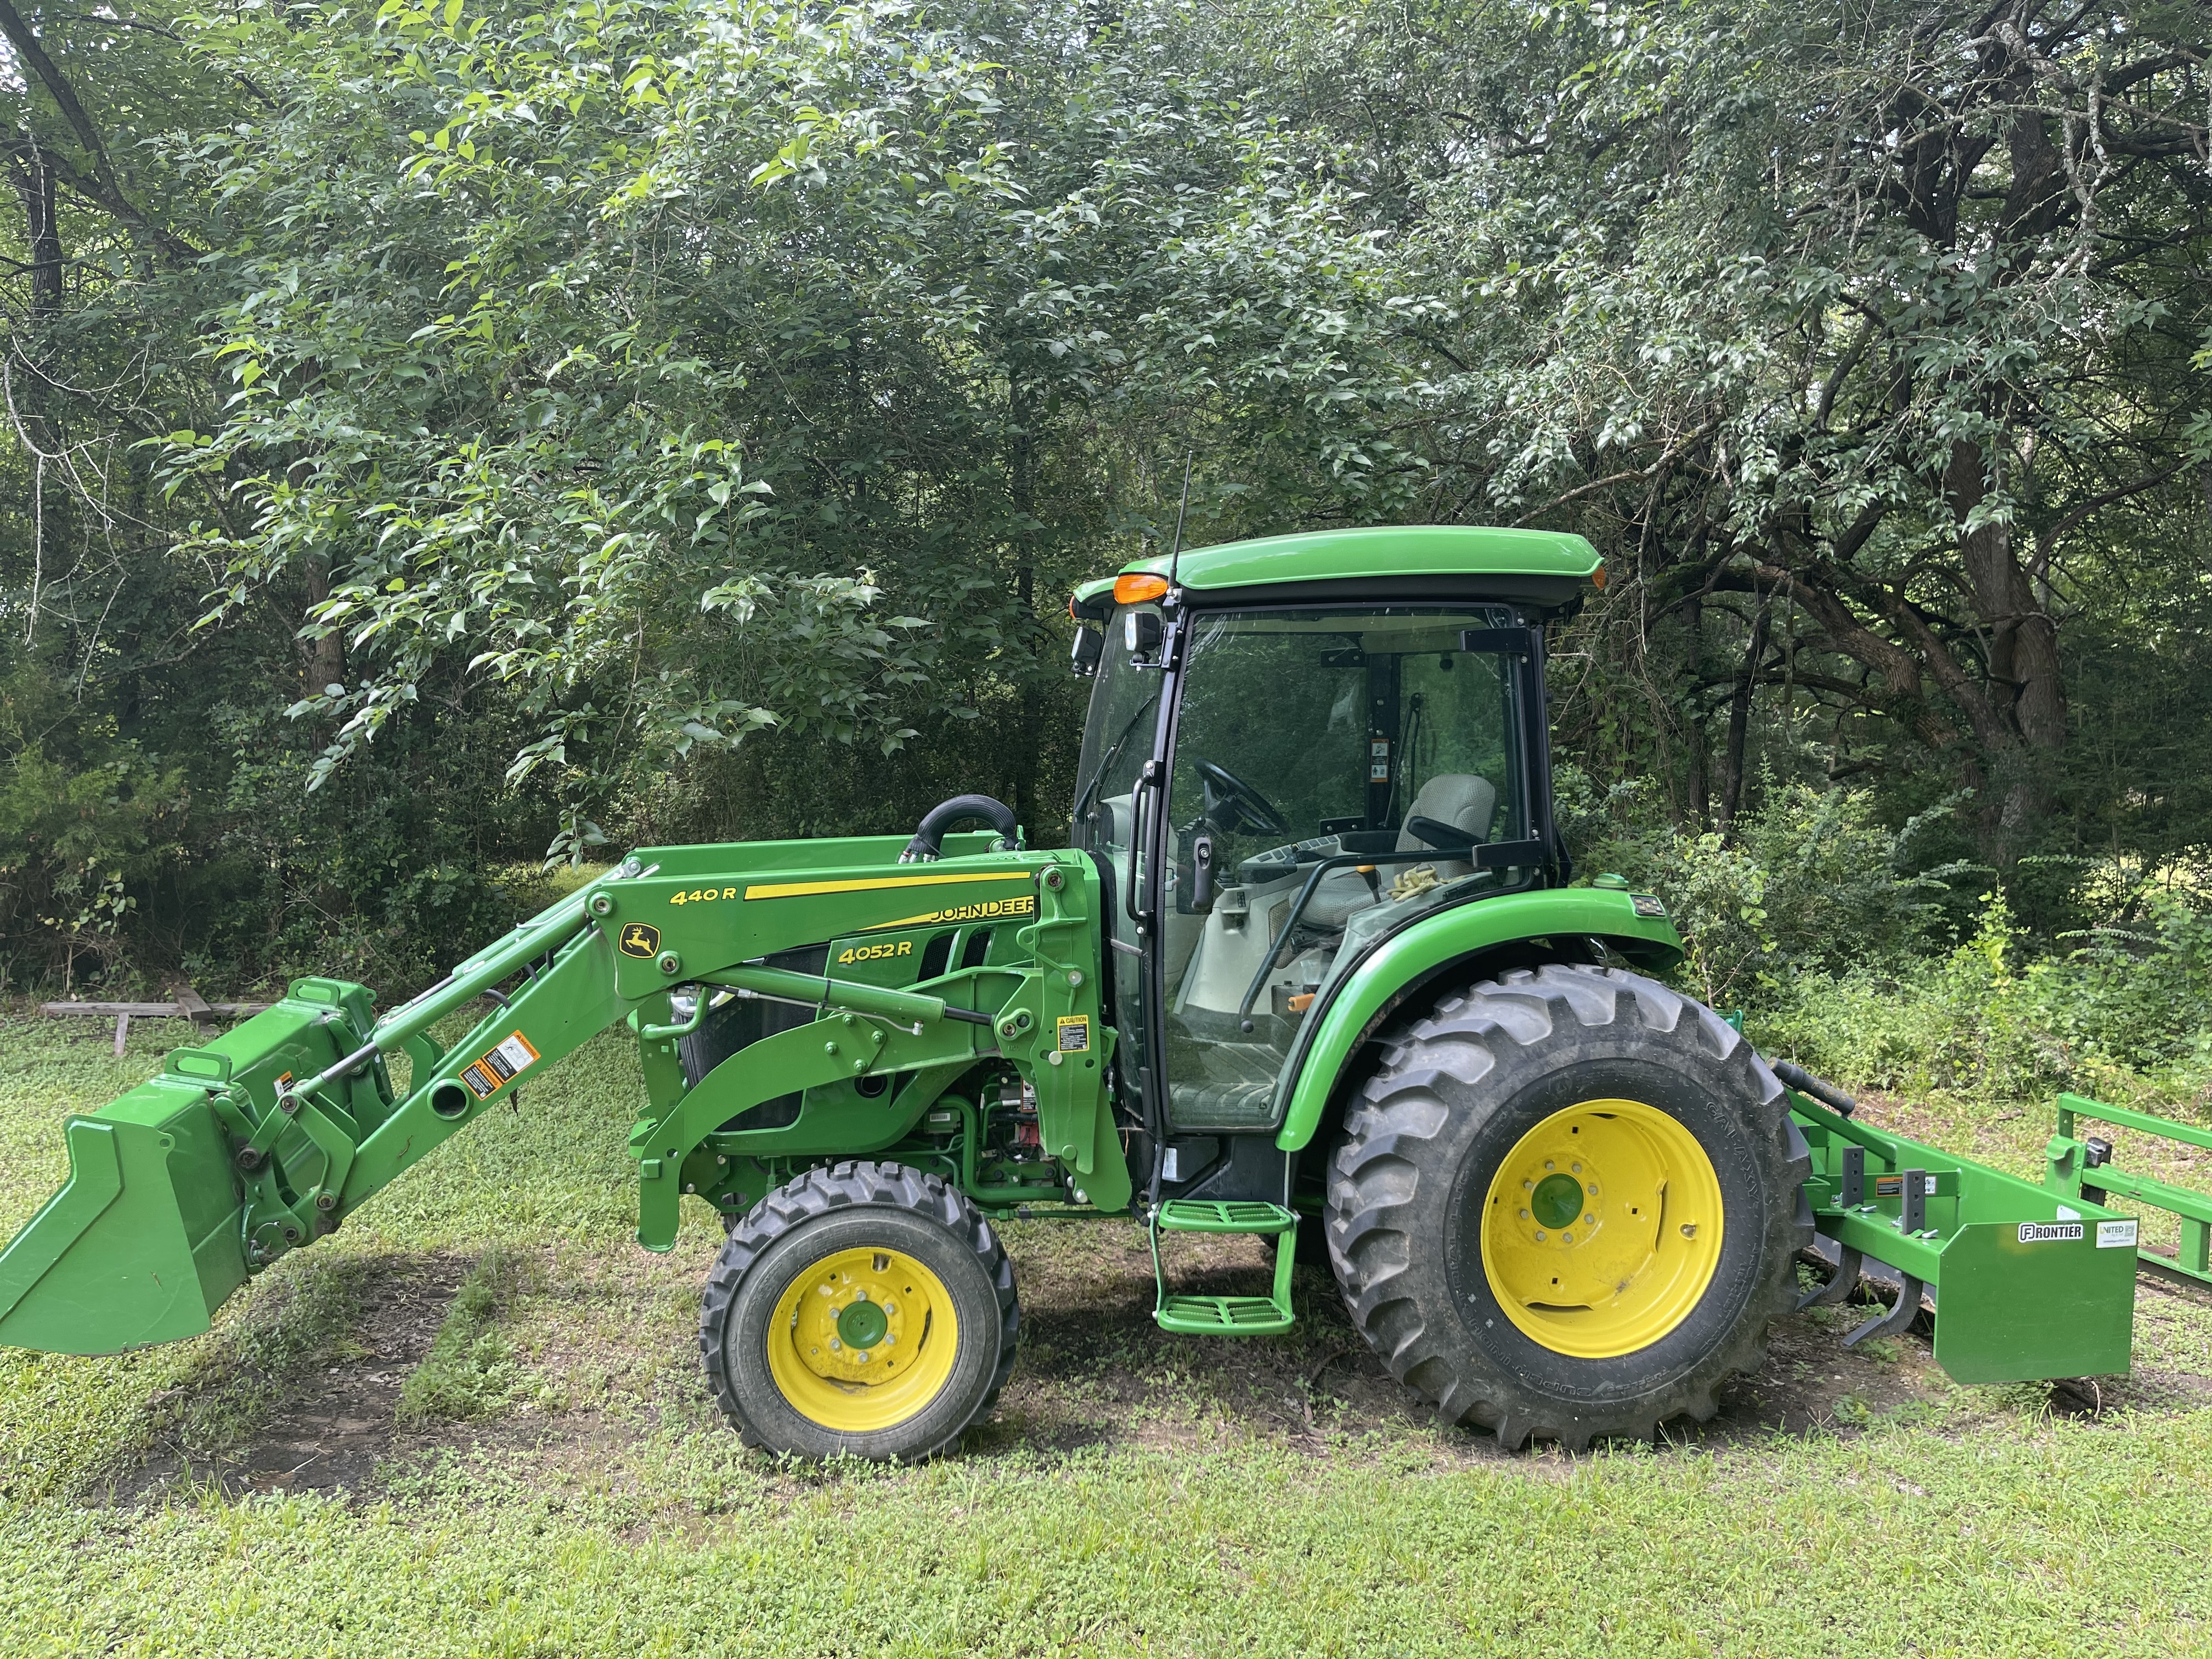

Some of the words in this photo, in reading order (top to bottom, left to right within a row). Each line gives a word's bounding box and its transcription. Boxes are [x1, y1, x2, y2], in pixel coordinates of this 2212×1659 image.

[669, 888, 719, 905] 440
[721, 887, 737, 900] R
[931, 904, 983, 920] JOHN
[838, 943, 895, 965] 4052
[897, 941, 913, 956] R
[521, 1037, 537, 1057] WARNING
[482, 1068, 498, 1086] WARNING
[1706, 1102, 1760, 1200] GALAXY
[2020, 1224, 2081, 1240] FRONTIER
[2100, 1226, 2124, 1234] UNITED
[1515, 1365, 1592, 1397] SUPER
